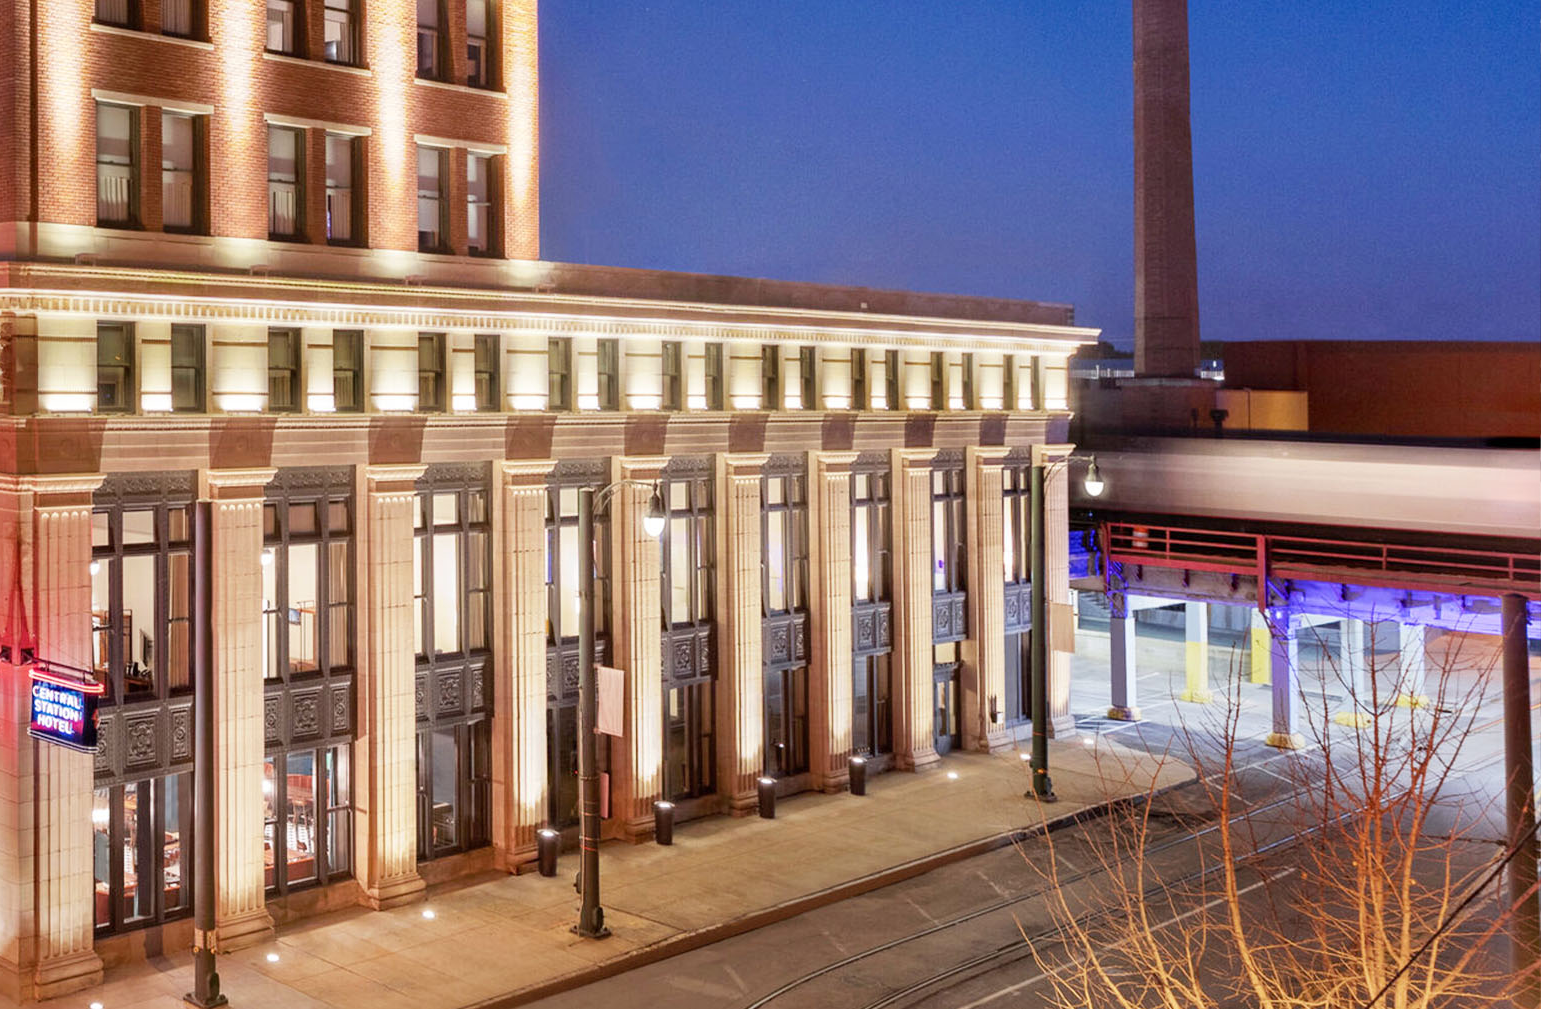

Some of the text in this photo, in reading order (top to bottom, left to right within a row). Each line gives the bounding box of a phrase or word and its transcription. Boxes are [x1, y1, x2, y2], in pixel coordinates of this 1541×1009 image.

[32, 684, 82, 709] CENTRAL
[34, 699, 81, 722] STATION
[37, 713, 74, 735] HOTEL
